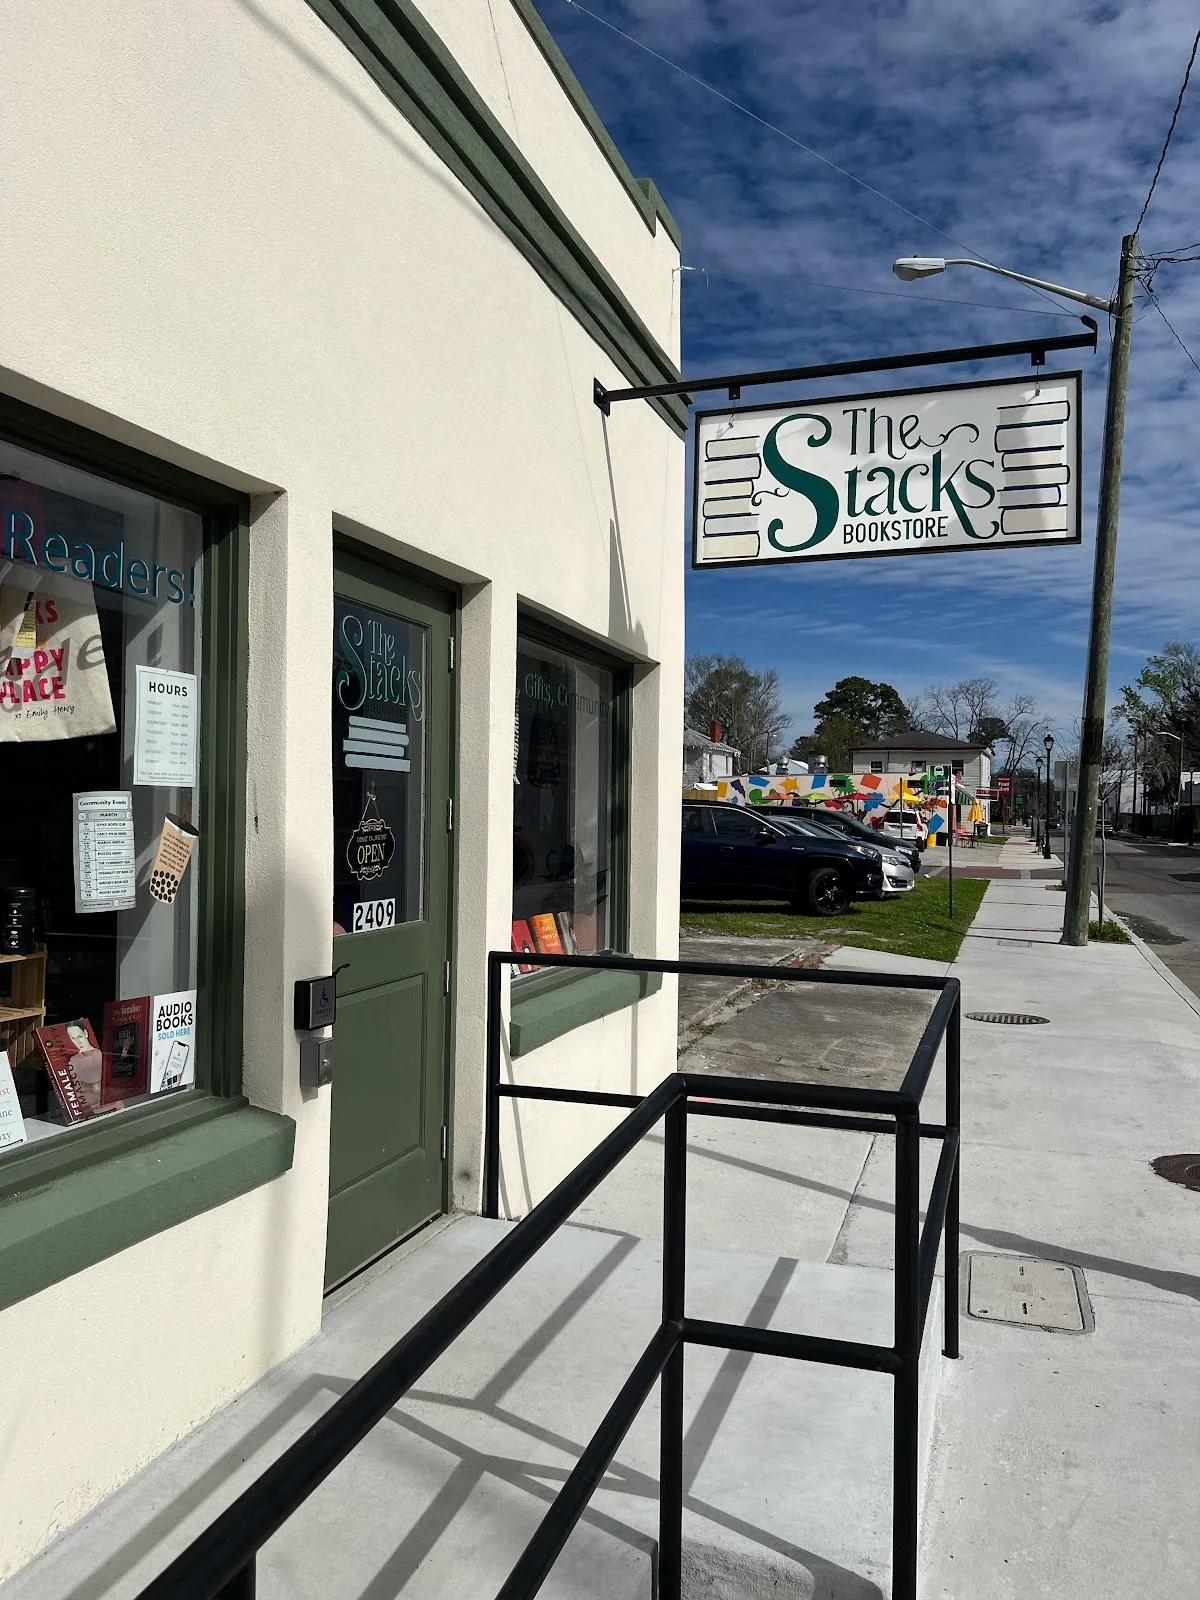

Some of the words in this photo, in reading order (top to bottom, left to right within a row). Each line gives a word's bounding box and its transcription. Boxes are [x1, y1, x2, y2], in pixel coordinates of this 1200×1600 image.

[843, 407, 979, 459] The
[751, 413, 1000, 552] Stacks
[843, 516, 949, 544] BOOKSTORE
[5, 510, 196, 608] Readers!
[367, 619, 397, 667] The
[335, 614, 424, 723] Stacks
[148, 681, 188, 697] HOURS
[357, 843, 386, 865] OPEN
[356, 901, 394, 931] 2409
[156, 1014, 193, 1032] BOOKS
[158, 1002, 192, 1018] AUDIO
[158, 1032, 175, 1041] SOLD
[176, 1028, 191, 1038] HERE
[58, 1068, 82, 1116] FEMALE
